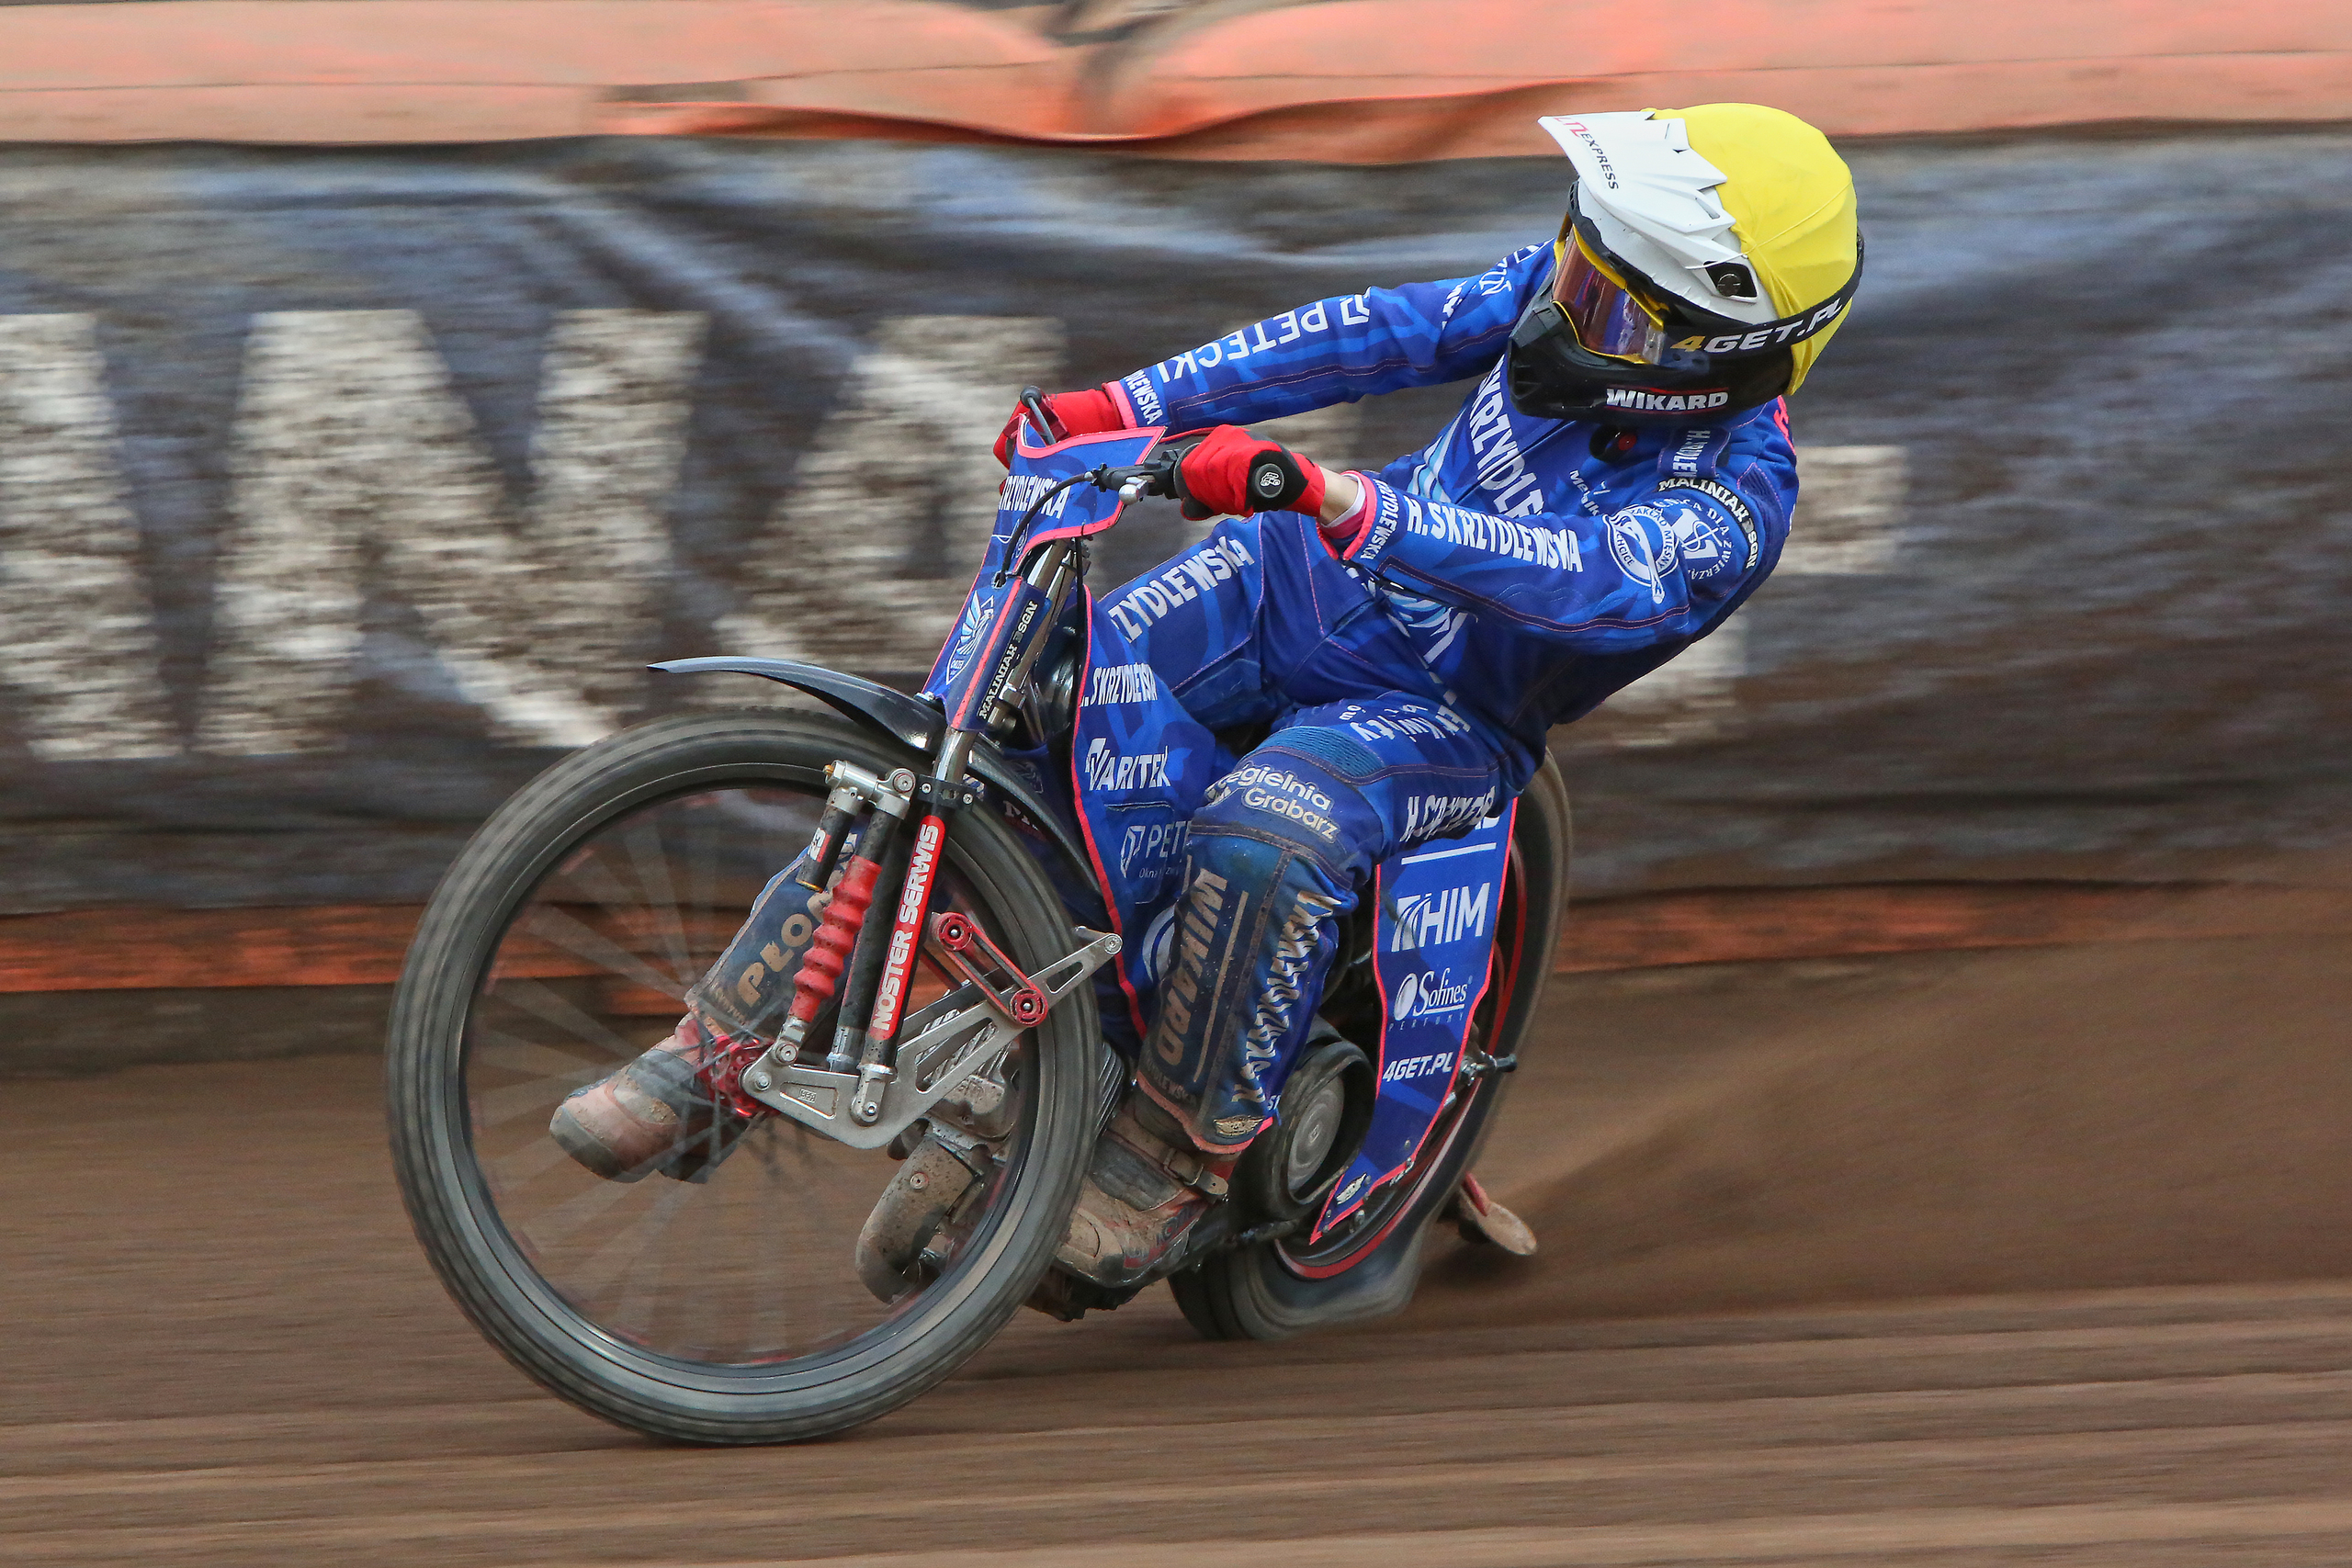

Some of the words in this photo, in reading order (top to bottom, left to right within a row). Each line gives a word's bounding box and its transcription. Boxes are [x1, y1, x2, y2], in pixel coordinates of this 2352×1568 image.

[1580, 132, 1619, 189] EXPRESS
[1156, 300, 1329, 383] PETECKI
[1670, 298, 1843, 354] 4GET.PL
[1606, 388, 1729, 412] WIKARD
[1429, 502, 1583, 572] SKRZYDLEWSKA
[1108, 535, 1256, 644] ZYDLEWSKA
[1085, 742, 1171, 792] VARITEK
[1243, 787, 1339, 840] Grabarz
[873, 929, 913, 1032] NOSTER
[899, 822, 940, 926] SERWIS
[1156, 867, 1228, 1066] WIKARD
[1412, 967, 1468, 1017] Sofines
[1382, 1051, 1454, 1082] 4GET.PL
